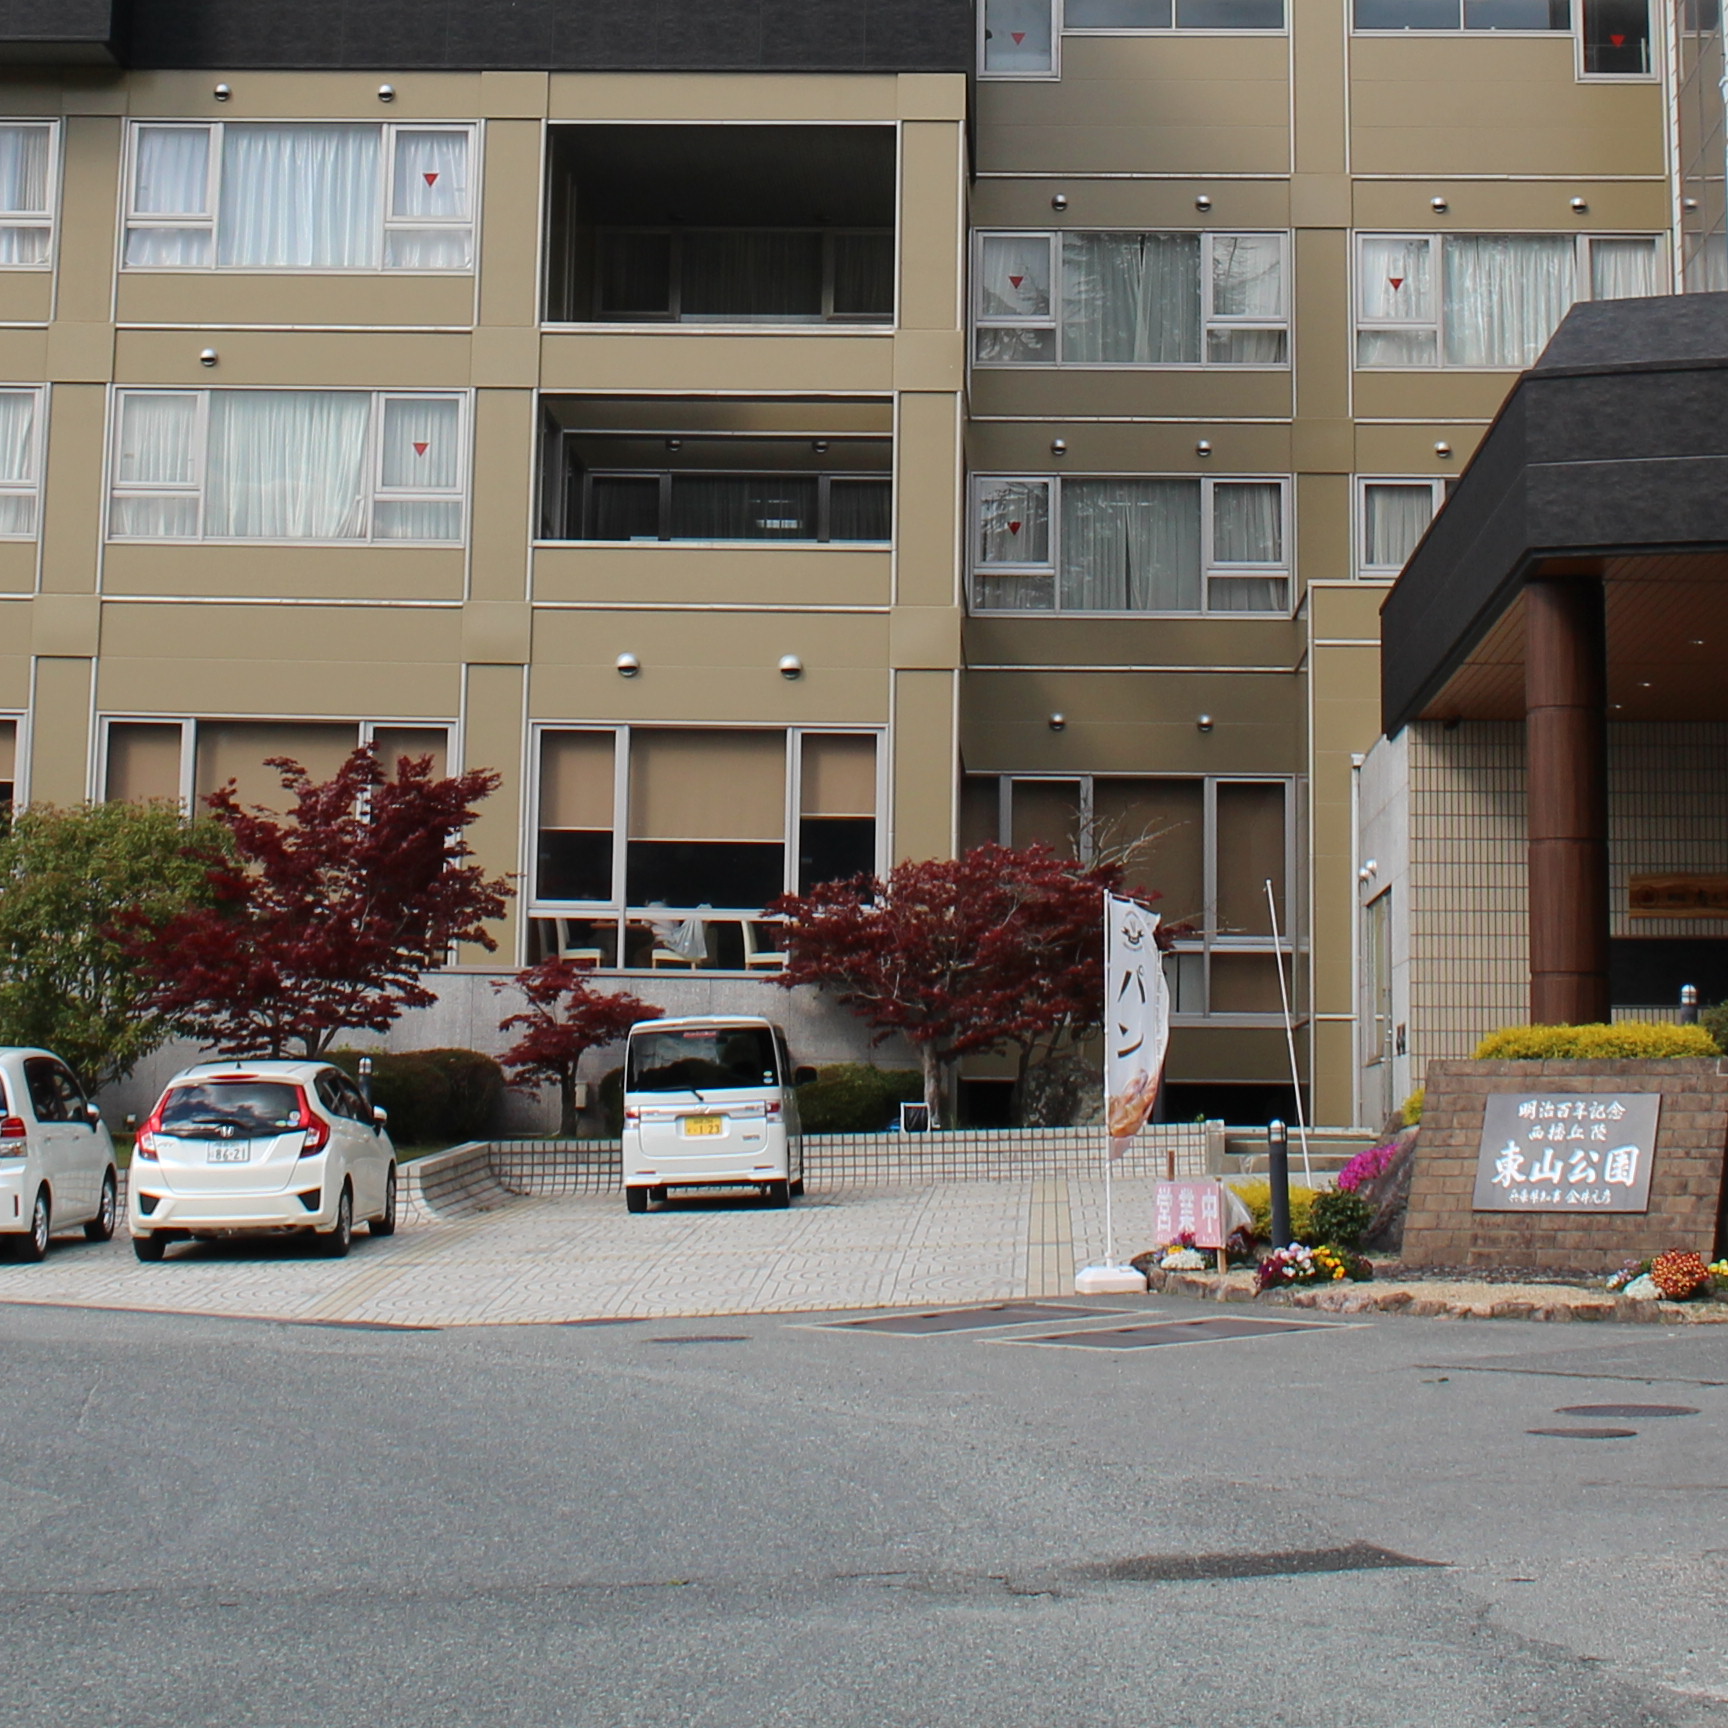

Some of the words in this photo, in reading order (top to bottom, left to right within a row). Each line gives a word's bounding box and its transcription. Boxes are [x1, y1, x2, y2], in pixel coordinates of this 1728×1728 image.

[1117, 965, 1146, 1059] パン
[1518, 1099, 1627, 1121] 明治百年記念
[1490, 1139, 1640, 1188] 東山公園
